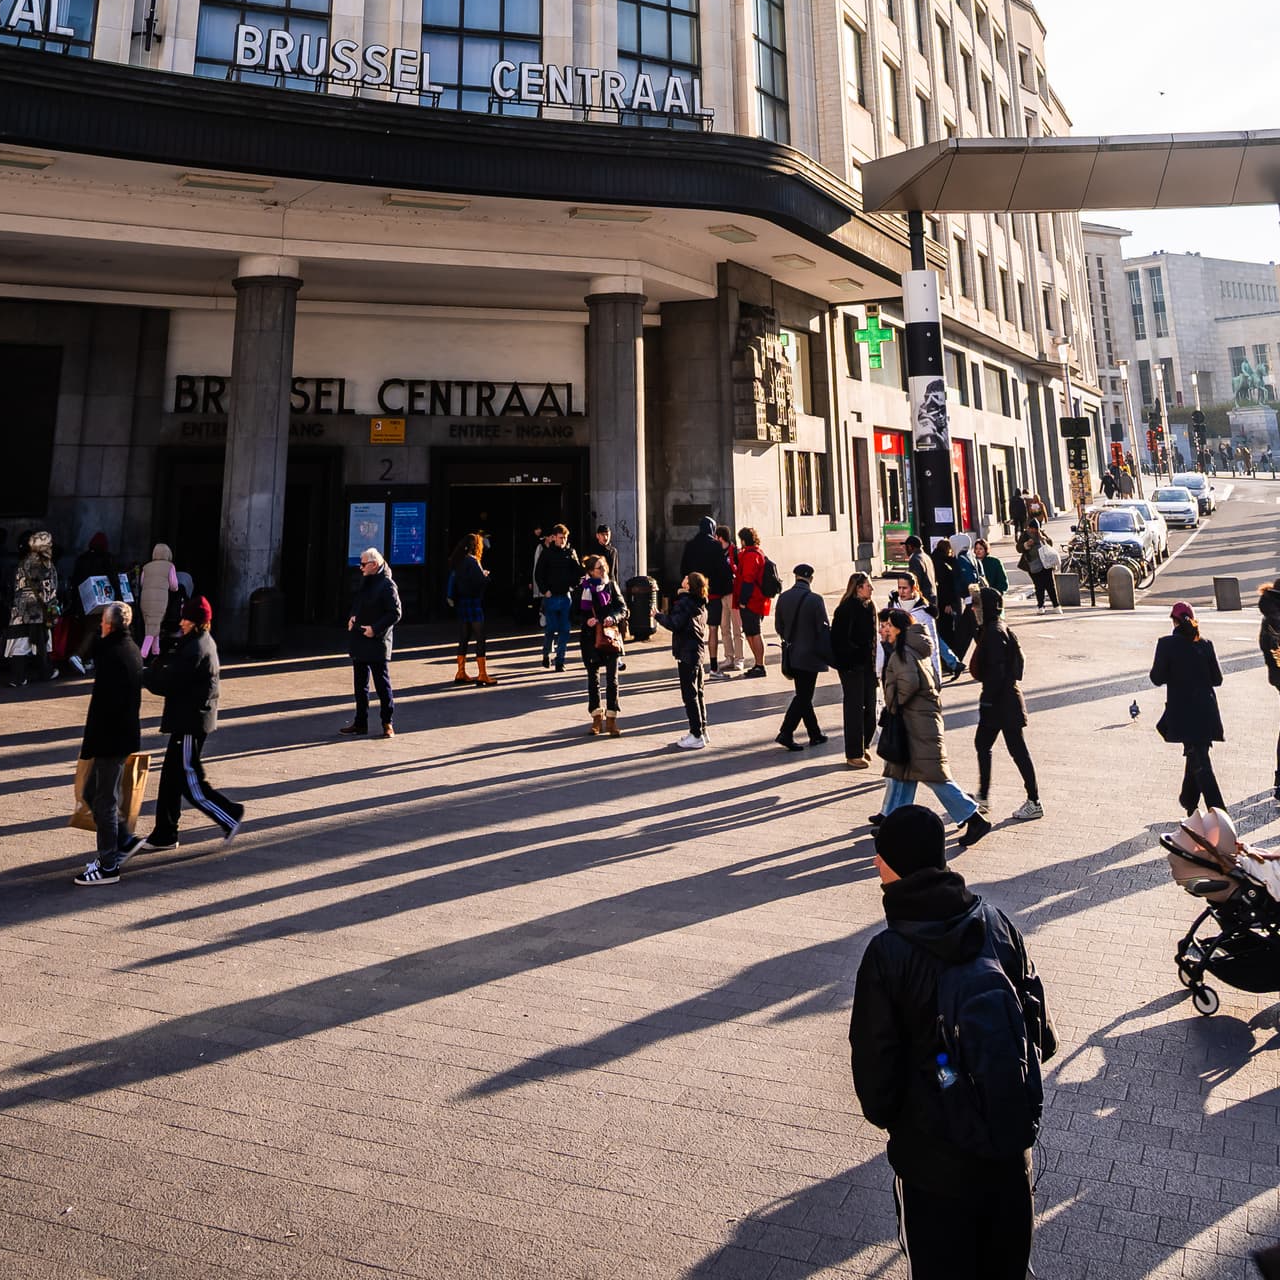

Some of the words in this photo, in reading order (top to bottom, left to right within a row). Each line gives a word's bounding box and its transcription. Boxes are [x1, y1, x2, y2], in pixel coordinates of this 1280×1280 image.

[236, 24, 444, 95] BRUSSEL
[492, 60, 715, 117] CENTRAAL
[174, 375, 356, 415] BRSEL
[377, 378, 583, 417] CENTRAAL
[182, 422, 228, 437] ENTR
[288, 422, 325, 437] ANG
[515, 424, 574, 438] INGANG
[379, 458, 393, 481] 2
